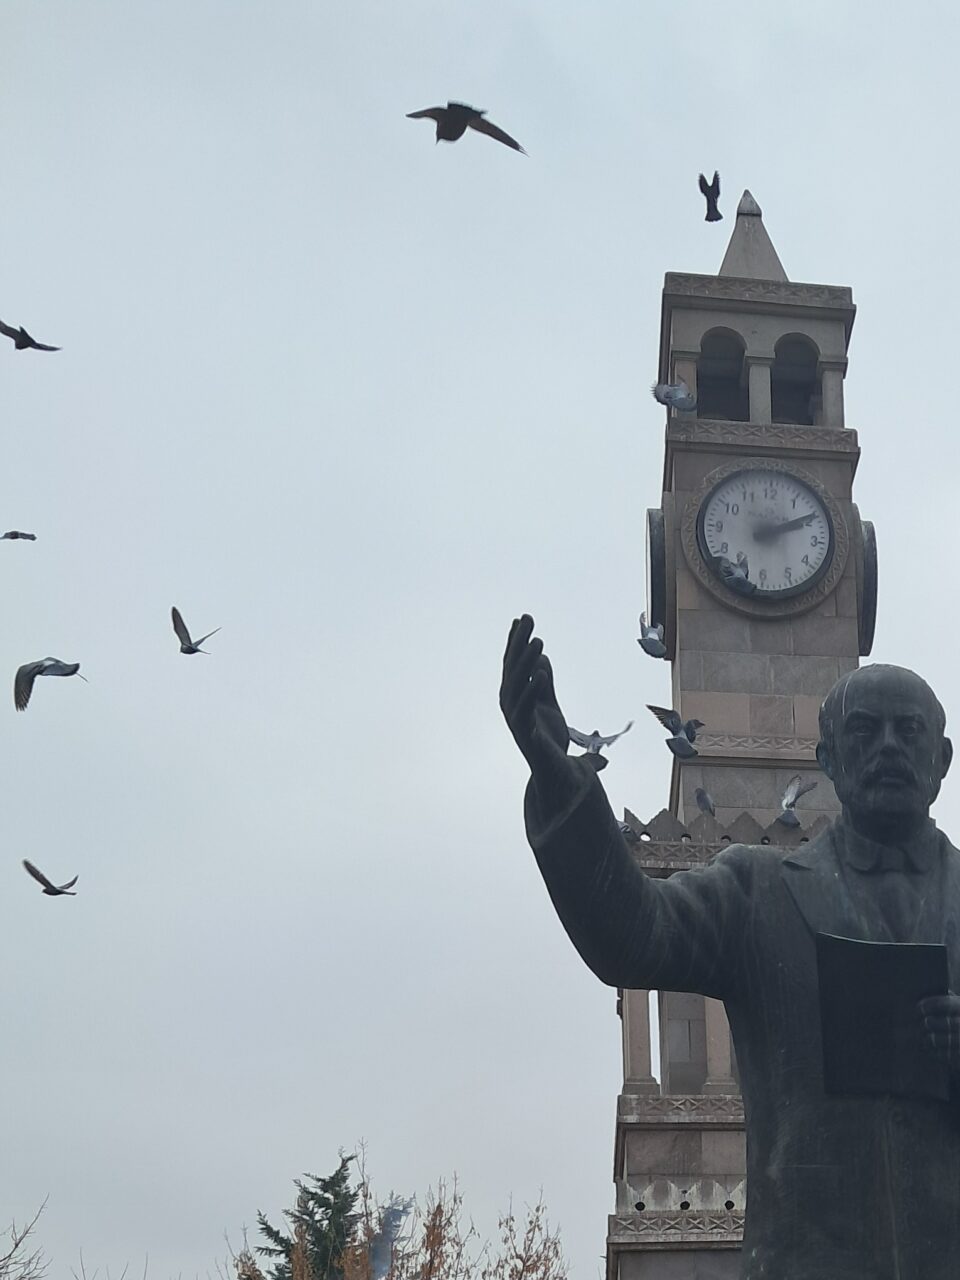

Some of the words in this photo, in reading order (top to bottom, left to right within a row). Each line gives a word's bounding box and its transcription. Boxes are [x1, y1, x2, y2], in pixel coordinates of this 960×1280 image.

[742, 490, 755, 503] 11
[763, 488, 777, 499] 12
[725, 503, 739, 516] 10
[714, 520, 724, 532] 9
[810, 535, 818, 547] 3
[720, 542, 728, 554] 8
[801, 555, 809, 566] 4
[759, 569, 767, 580] 6
[784, 568, 792, 579] 5
